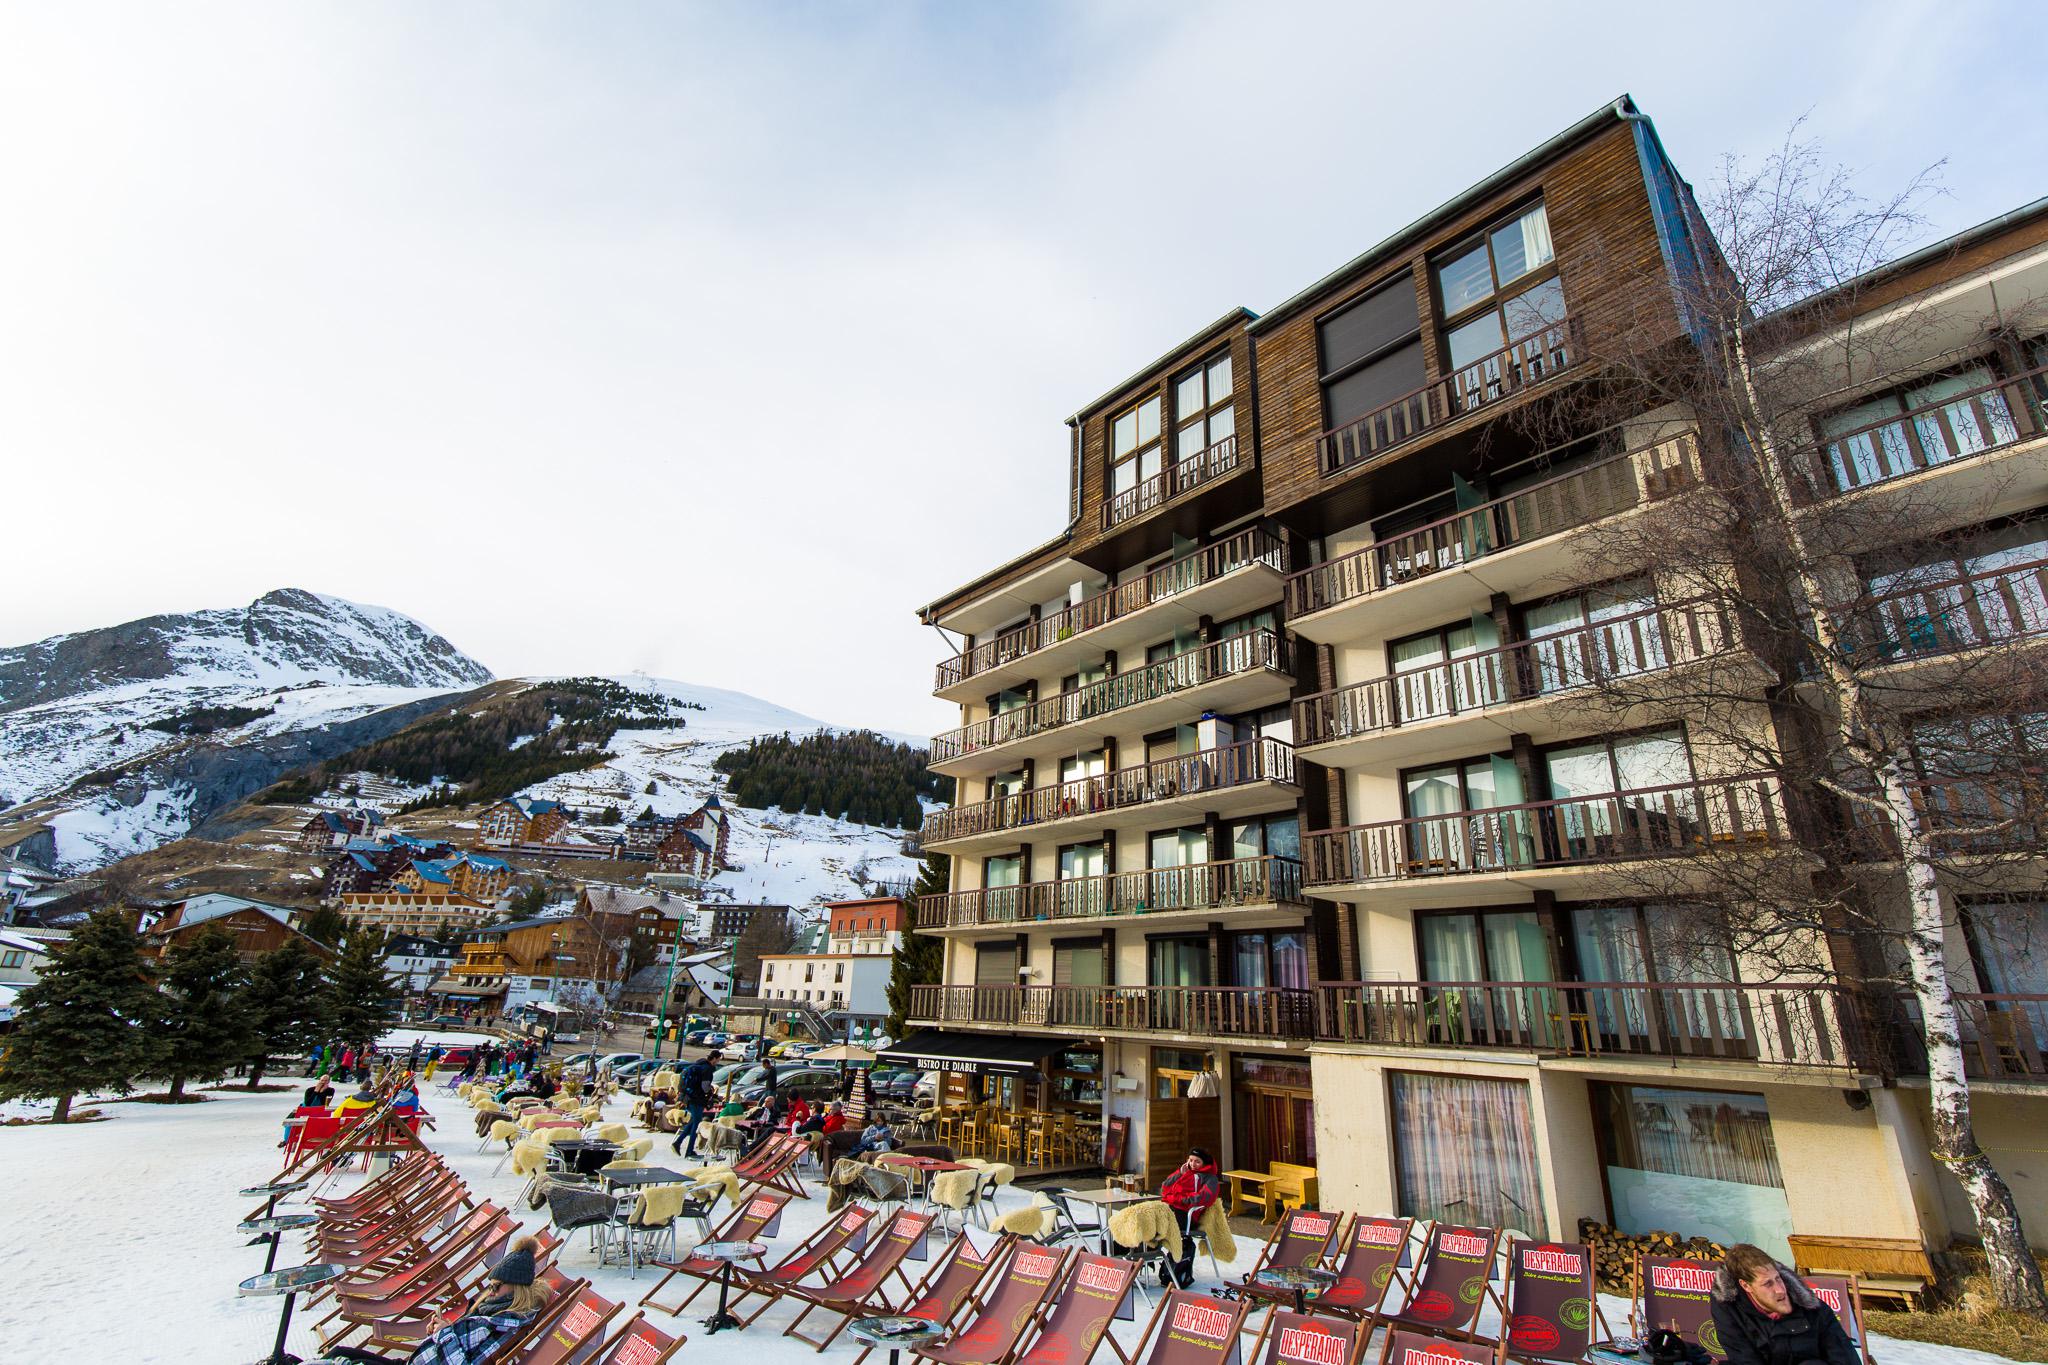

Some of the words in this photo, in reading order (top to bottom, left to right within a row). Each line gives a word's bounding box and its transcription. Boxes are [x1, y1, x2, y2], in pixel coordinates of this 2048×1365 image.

[917, 1059, 940, 1070] BISTRO
[941, 1060, 950, 1071] LE
[952, 1061, 977, 1073] DIABLE
[1290, 1216, 1330, 1236] DESPERADOS
[1359, 1224, 1402, 1245] DESPERADOS
[1439, 1233, 1488, 1257] DESPERADOS
[1012, 1251, 1056, 1279] DESPERADOS
[1523, 1249, 1582, 1275] DESPERADOS
[1077, 1262, 1125, 1292] DESPERADOS
[1172, 1302, 1232, 1340] DESPERADOS
[1279, 1328, 1346, 1365] DESPERADOS
